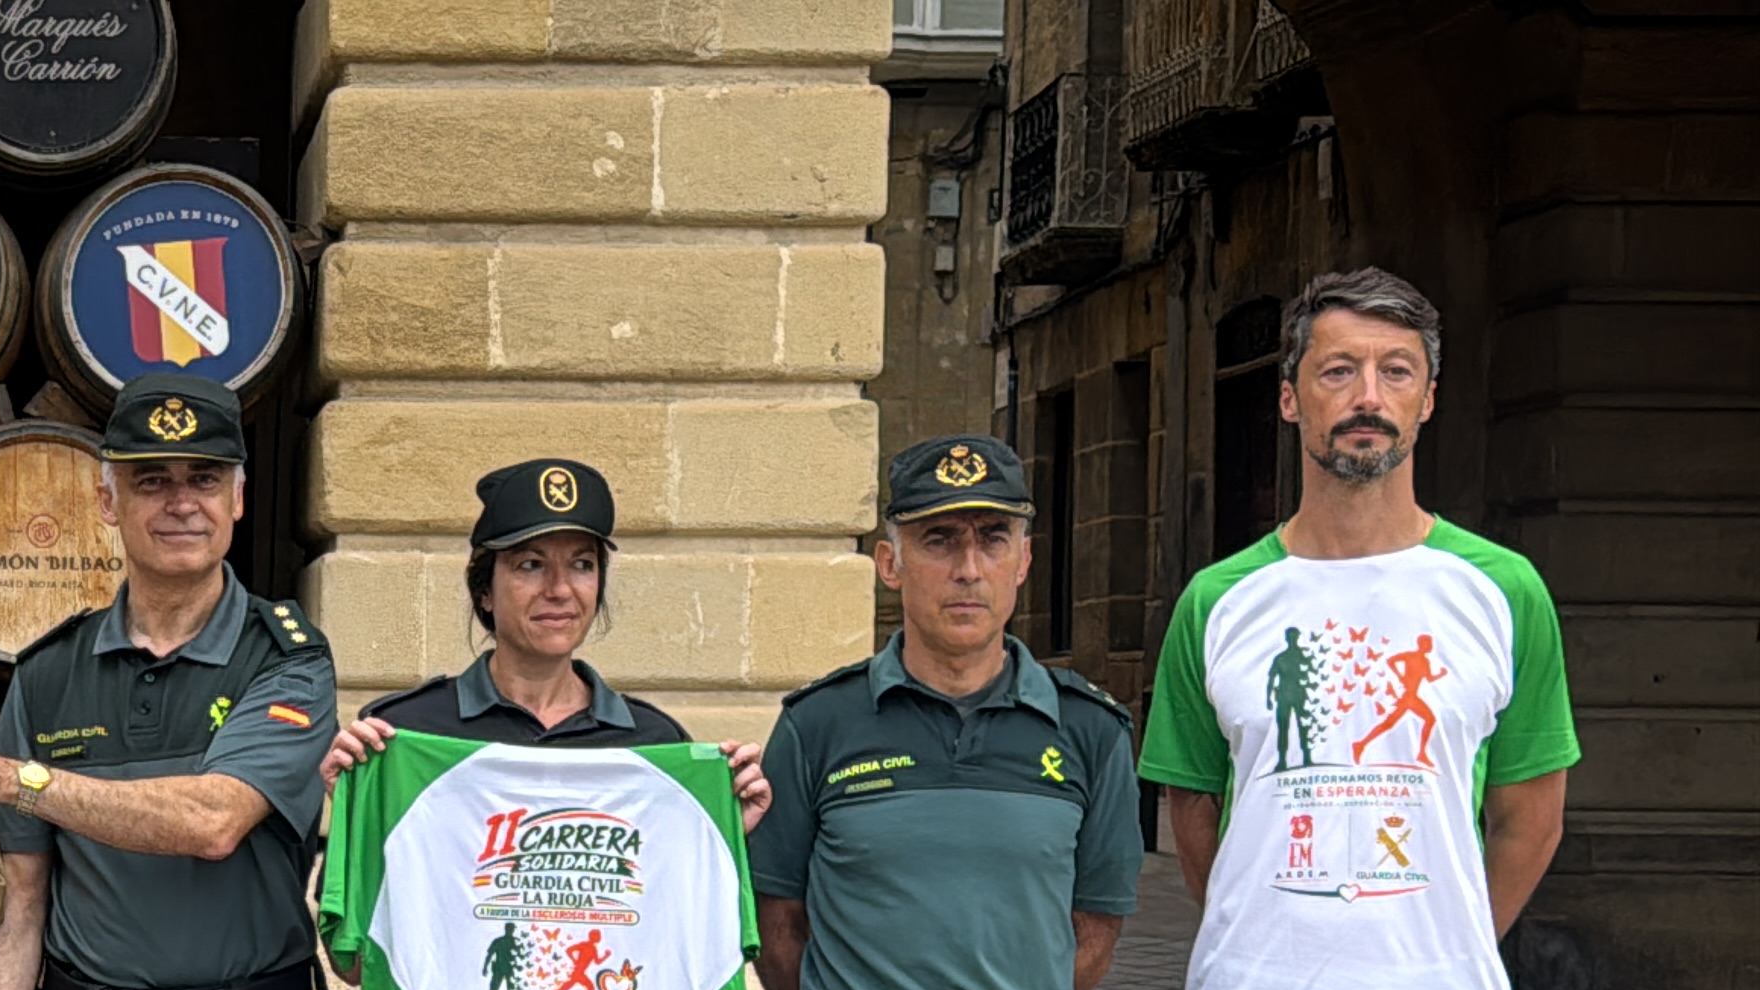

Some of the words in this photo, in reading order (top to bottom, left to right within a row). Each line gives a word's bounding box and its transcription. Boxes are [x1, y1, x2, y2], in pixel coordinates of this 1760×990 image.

[1, 39, 122, 81] Carrión
[103, 210, 175, 240] FUNDADA
[180, 209, 201, 220] EN
[206, 212, 240, 228] 1879
[46, 556, 123, 571] BILBAO
[37, 728, 79, 743] GUARDIA
[827, 761, 880, 784] GUARDIA
[882, 755, 916, 769] CIVIL
[1276, 774, 1382, 788] TRANSFORMAMOS
[1386, 773, 1425, 784] RETOS
[1293, 787, 1312, 799] EN
[1315, 786, 1411, 798] ESPERANZA
[518, 824, 643, 857] CARRERA
[518, 854, 619, 873] SOLIDARIA
[494, 873, 573, 892] GUARDIA
[577, 875, 625, 894] CIVIL
[1355, 871, 1402, 881] GUARDIA
[523, 891, 544, 905] LA
[547, 892, 594, 909] RIOJA
[511, 909, 520, 917] DE
[522, 909, 530, 918] LA
[532, 910, 587, 920] ESCLEROSIS
